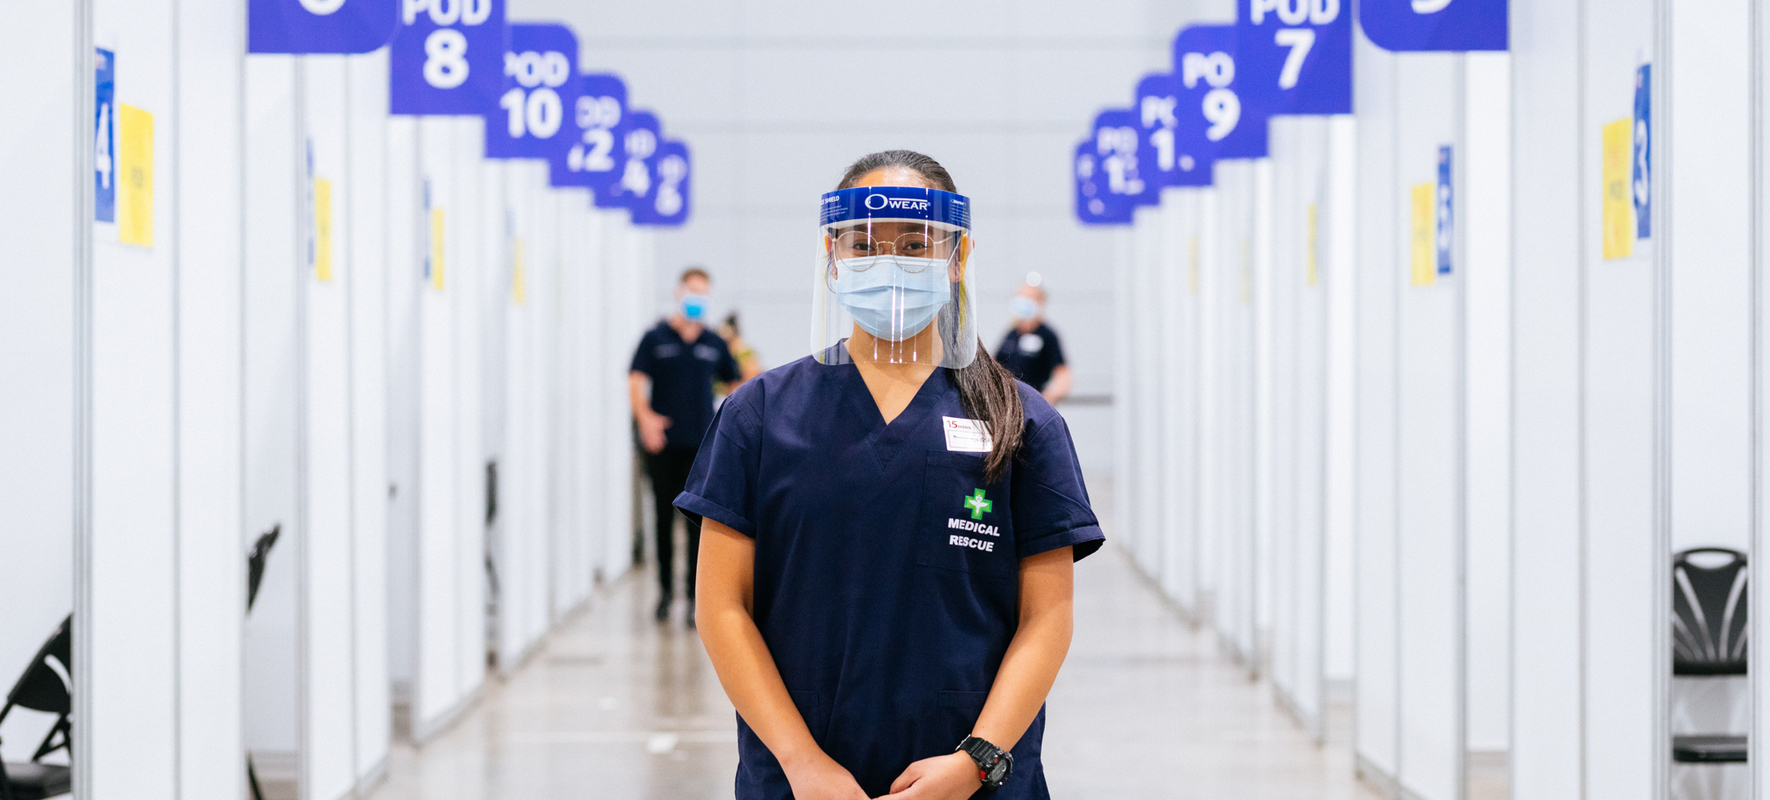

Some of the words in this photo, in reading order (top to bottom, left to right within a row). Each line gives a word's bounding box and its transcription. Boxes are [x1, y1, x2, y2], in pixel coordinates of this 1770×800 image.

[423, 28, 470, 89] 8
[1183, 52, 1235, 89] PO
[1275, 29, 1316, 90] 7
[500, 88, 563, 139] 10
[1202, 88, 1242, 142] 9
[948, 518, 1000, 537] MEDICAL
[949, 534, 994, 552] RESCUE
